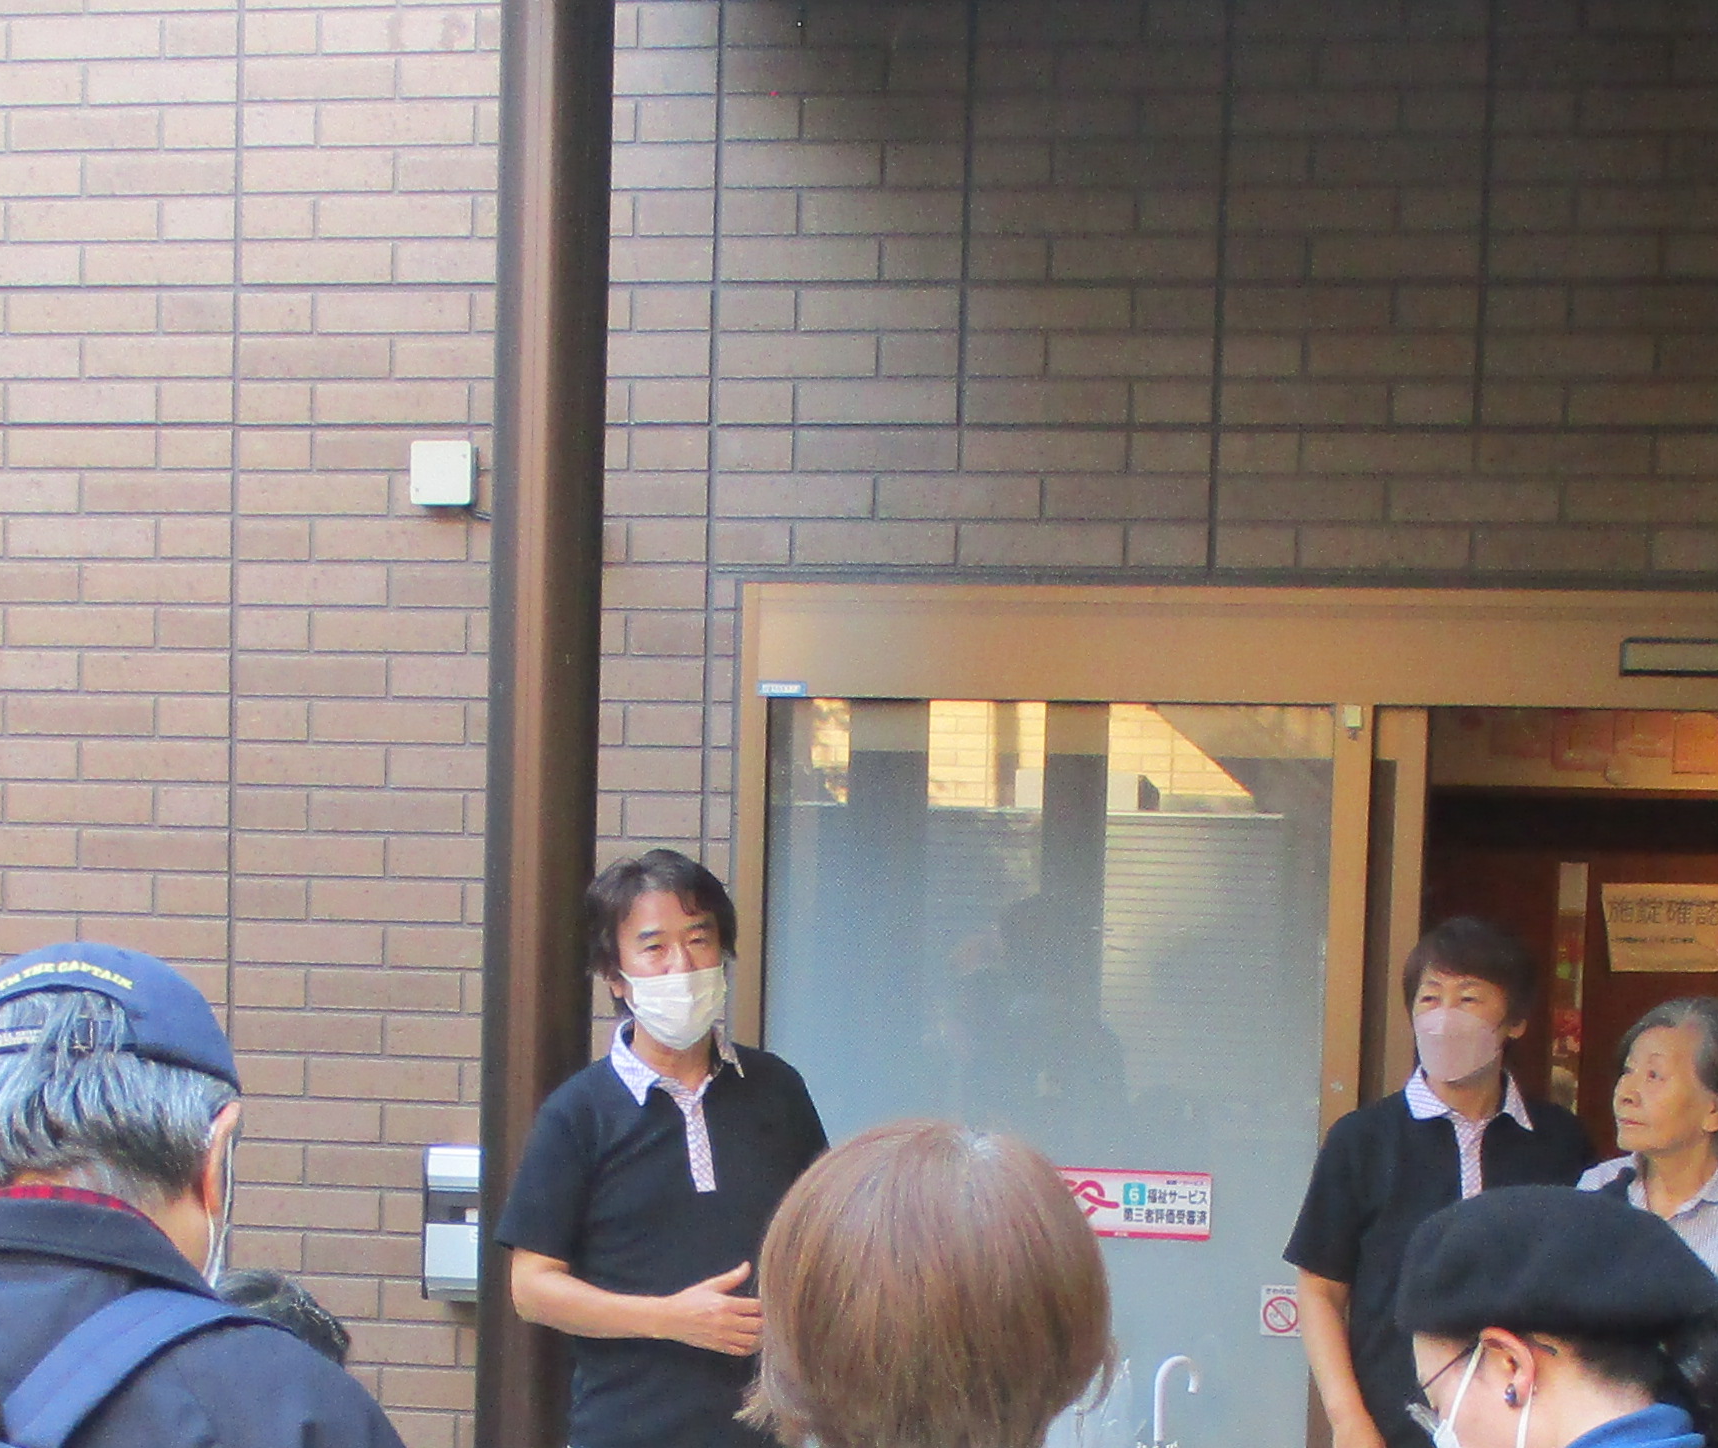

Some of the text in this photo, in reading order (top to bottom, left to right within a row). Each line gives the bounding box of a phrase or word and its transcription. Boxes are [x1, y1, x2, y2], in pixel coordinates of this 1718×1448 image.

[21, 962, 56, 979] THE
[57, 959, 135, 990] CAPTAIN
[1128, 1187, 1208, 1205] 6 福祉サービス
[1123, 1207, 1208, 1226] 第三者評価受審済
